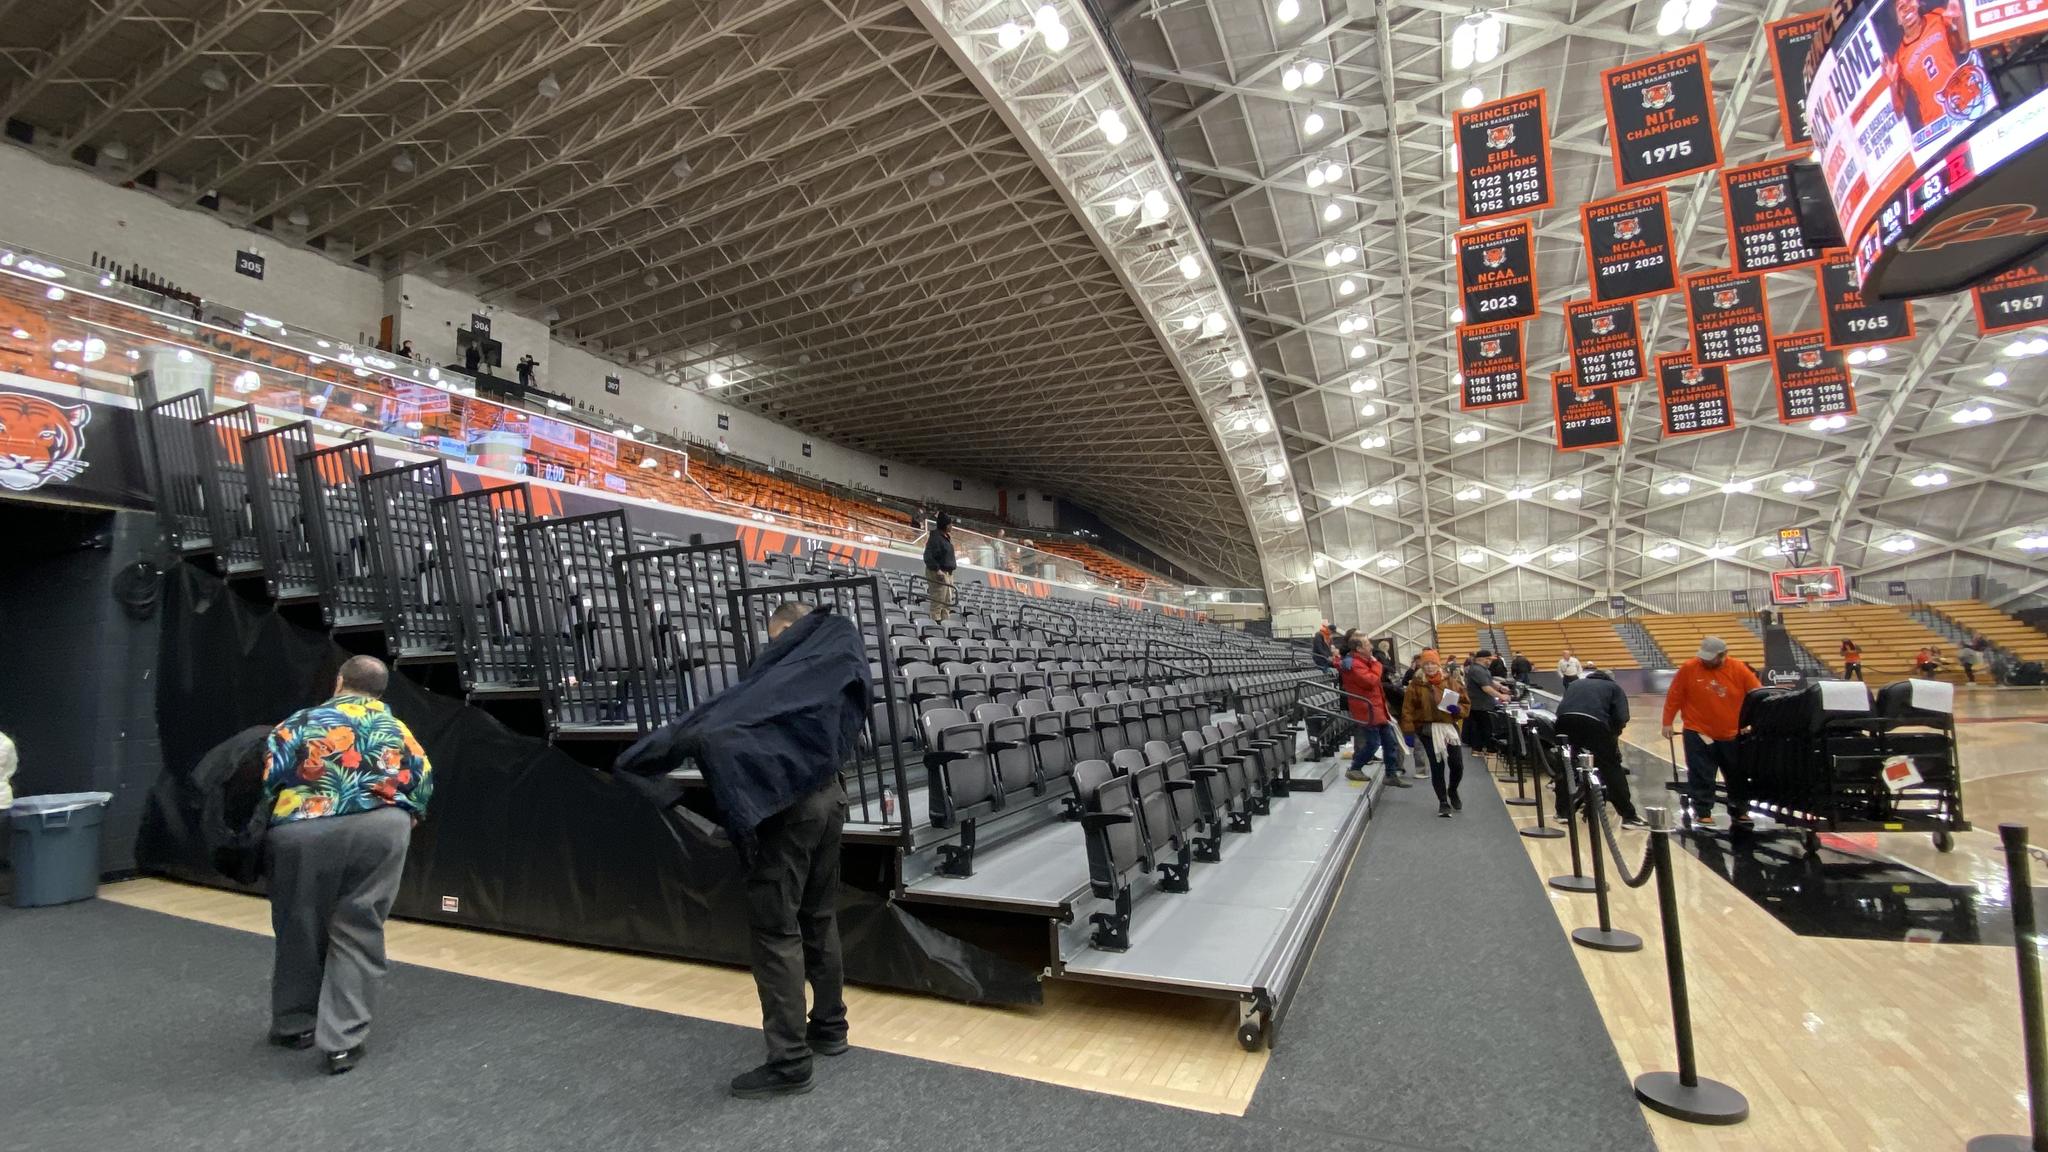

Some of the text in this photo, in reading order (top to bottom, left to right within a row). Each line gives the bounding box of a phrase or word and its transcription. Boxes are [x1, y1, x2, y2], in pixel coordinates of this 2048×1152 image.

[1790, 34, 1812, 44] MEN'S
[1612, 54, 1697, 86] PRINCETON
[1829, 23, 1882, 115] HOME
[1923, 55, 1939, 80] 2
[1622, 68, 1688, 90] MEN'S BASKETBALL
[1462, 99, 1538, 125] PRINCETON
[1645, 108, 1676, 126] NIT
[1470, 111, 1529, 129] MEN'S BASKETBALL
[1626, 115, 1700, 141] CHAMPIONS
[1488, 149, 1517, 163] EIBL
[1642, 140, 1692, 165] 1975
[1470, 155, 1537, 177] CHAMPIONS
[1472, 167, 1537, 189] 1922 1925
[1473, 179, 1538, 201] 1932 1950
[1924, 175, 1941, 200] 63
[1474, 191, 1539, 213] 1952 1955
[1590, 195, 1660, 218] PRINCETON
[1617, 206, 1654, 218] BASKETBALL
[1755, 207, 1793, 222] NCAA
[1740, 216, 1797, 233] TOURNAME
[1462, 226, 1525, 246] PRINCETON
[1486, 237, 1519, 248] BASKETBALL
[1743, 232, 1775, 245] 1996
[1612, 239, 1646, 253] NCAA
[1745, 243, 1776, 256] 1998
[1598, 245, 1663, 264] TOURNAMENT
[1746, 255, 1778, 268] 2004
[1783, 249, 1814, 262] 2011
[240, 258, 261, 273] 305
[1602, 255, 1664, 276] 2017 2023
[1478, 268, 1514, 283] NCAA
[1690, 274, 1749, 288] PRINCE
[1466, 275, 1529, 293] SWEET SIXTEEN
[1716, 278, 1751, 289] BASKETBALL
[1480, 295, 1517, 312] 2023
[1593, 306, 1625, 316] BASKETBALL
[1834, 301, 1867, 312] FINAL
[2000, 295, 2043, 313] 1967
[1702, 306, 1755, 321] IVY LEAGUE
[474, 320, 489, 332] 306
[1462, 322, 1517, 337] PRINCETON
[1696, 313, 1763, 331] CHAMPIONS
[1848, 316, 1888, 332] 1965
[1483, 331, 1511, 340] BASKETBALL
[1581, 332, 1629, 346] IVY LEAGUE
[1702, 325, 1759, 341] 1959 1960
[1575, 339, 1636, 356] CHAMPIONS
[1703, 335, 1761, 350] 1961 1963
[1582, 349, 1634, 365] 1967 1968
[1704, 344, 1763, 360] 1964 1965
[1470, 356, 1513, 368] IVY LEAGUE
[1583, 358, 1635, 374] 1969 1976
[1465, 363, 1520, 377] CHAMPIONS
[1584, 368, 1636, 384] 1977 1980
[1787, 367, 1837, 379] IVY LEAGUE
[1470, 373, 1517, 385] 1981 1983
[1782, 374, 1845, 389] CHAMPIONS
[1471, 382, 1518, 394] 1984 1989
[1671, 383, 1717, 395] IVY LEAGUE
[1788, 384, 1843, 398] 1992 1996
[1471, 391, 1517, 403] 1990 1991
[1666, 390, 1726, 404] CHAMPIONS
[1789, 393, 1844, 407] 1997 1998
[1566, 404, 1608, 415] TOURNAMENT
[1672, 399, 1722, 413] 2004 2011
[1790, 402, 1845, 416] 2001 2002
[1562, 408, 1612, 421] CHAMPIONS
[1673, 408, 1723, 422] 2017 2022
[1565, 416, 1611, 429] 2017 2023
[1674, 417, 1725, 431] 2023 2024
[806, 538, 823, 552] 114
